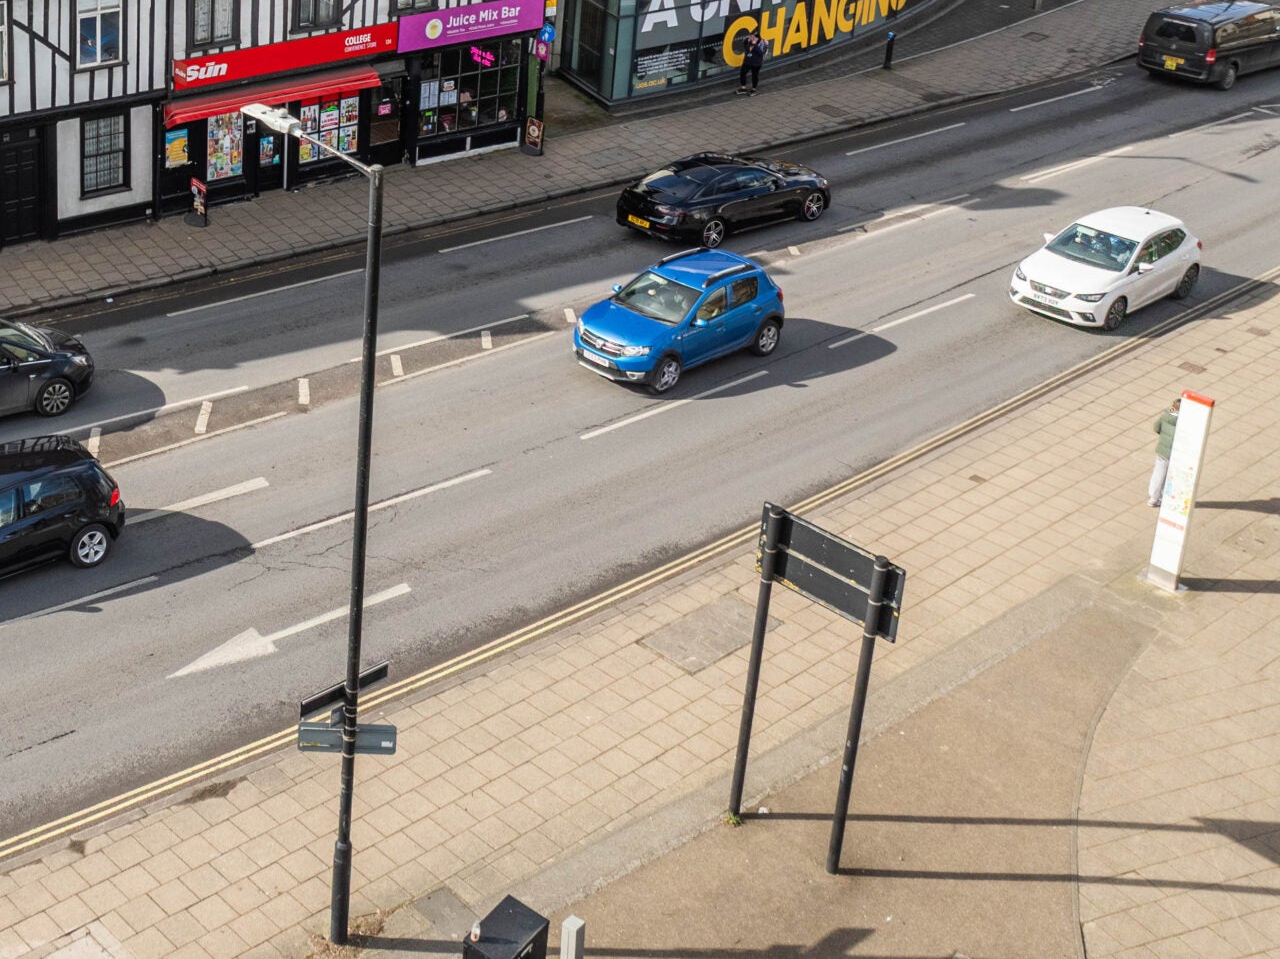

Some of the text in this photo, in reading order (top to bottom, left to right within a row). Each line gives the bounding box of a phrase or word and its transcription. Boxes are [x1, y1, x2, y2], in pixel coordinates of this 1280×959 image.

[446, 13, 476, 28] Juice
[479, 9, 499, 23] Mix
[501, 6, 521, 19] Bar
[345, 33, 372, 46] COLLEGE
[186, 62, 228, 82] Sun
